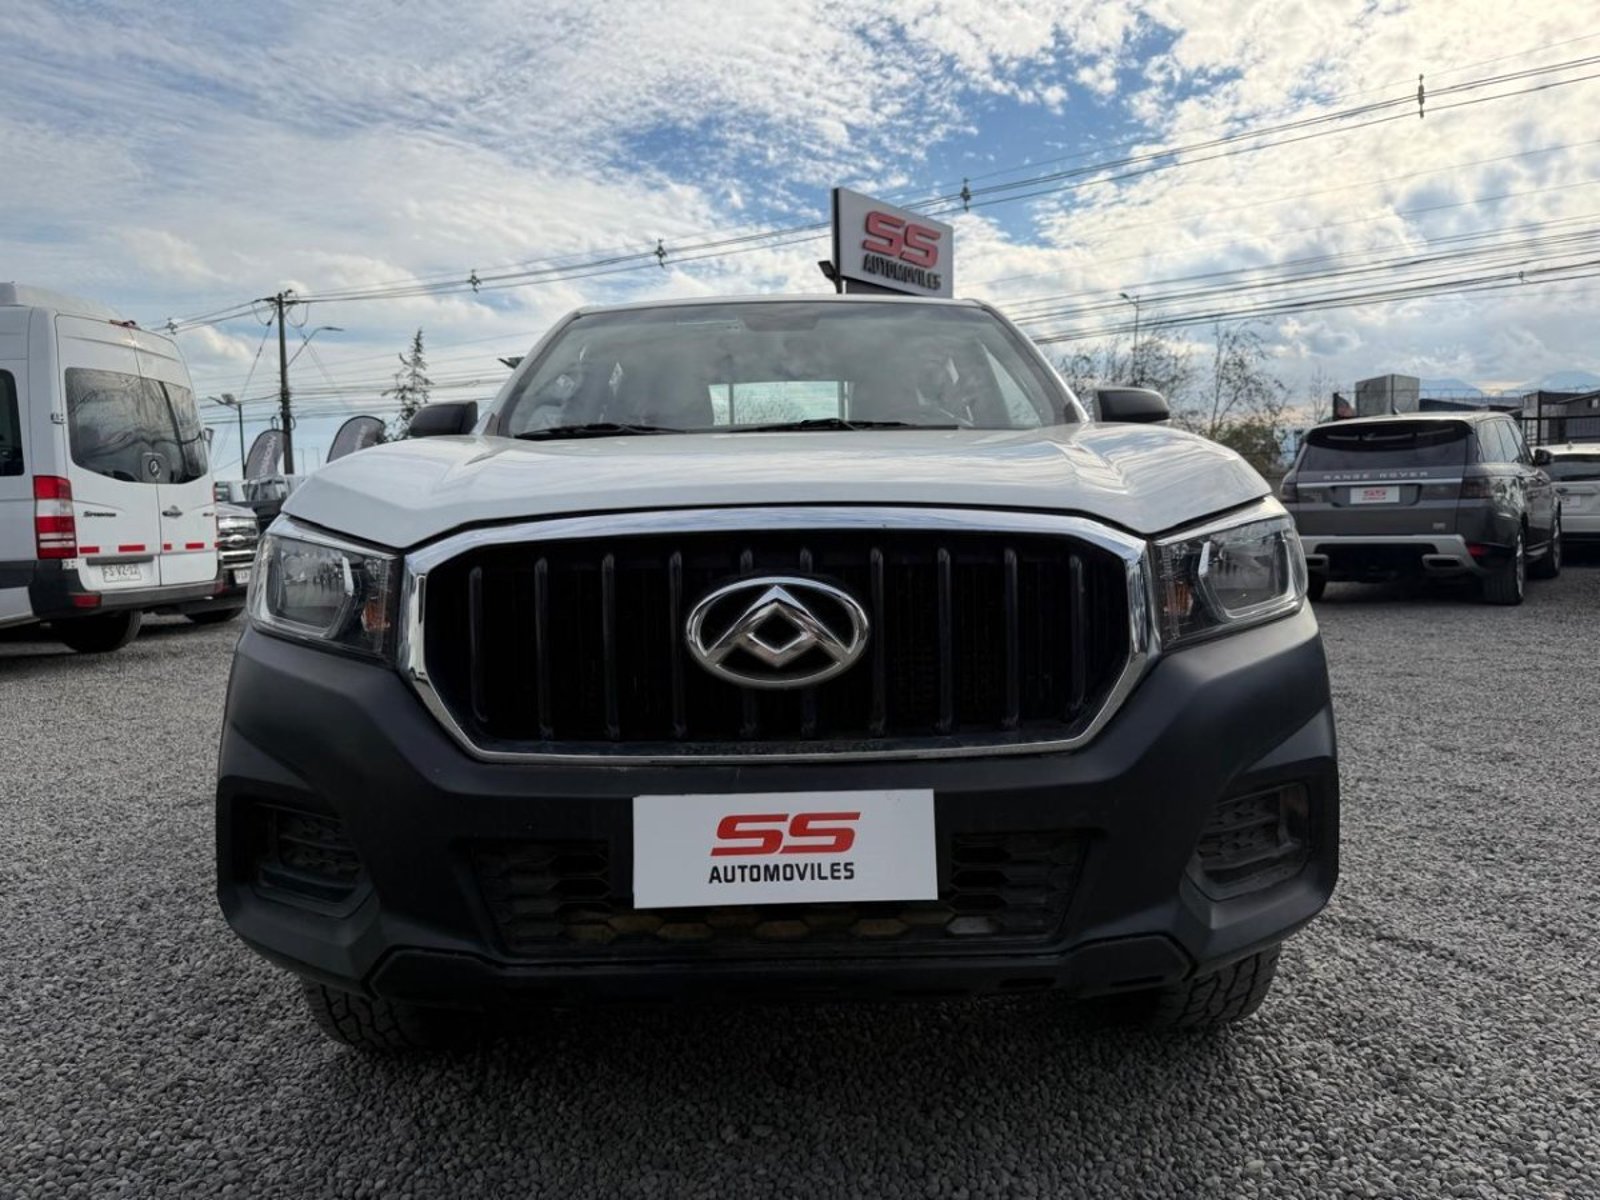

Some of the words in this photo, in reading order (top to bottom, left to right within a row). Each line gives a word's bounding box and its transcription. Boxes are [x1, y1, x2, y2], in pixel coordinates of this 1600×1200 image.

[862, 211, 941, 268] SS
[863, 254, 941, 291] AUTOMOVILES
[1322, 473, 1370, 481] RANGE
[1379, 471, 1429, 479] ROVER
[710, 811, 861, 856] SS
[708, 861, 855, 884] AUTOMOVILES
